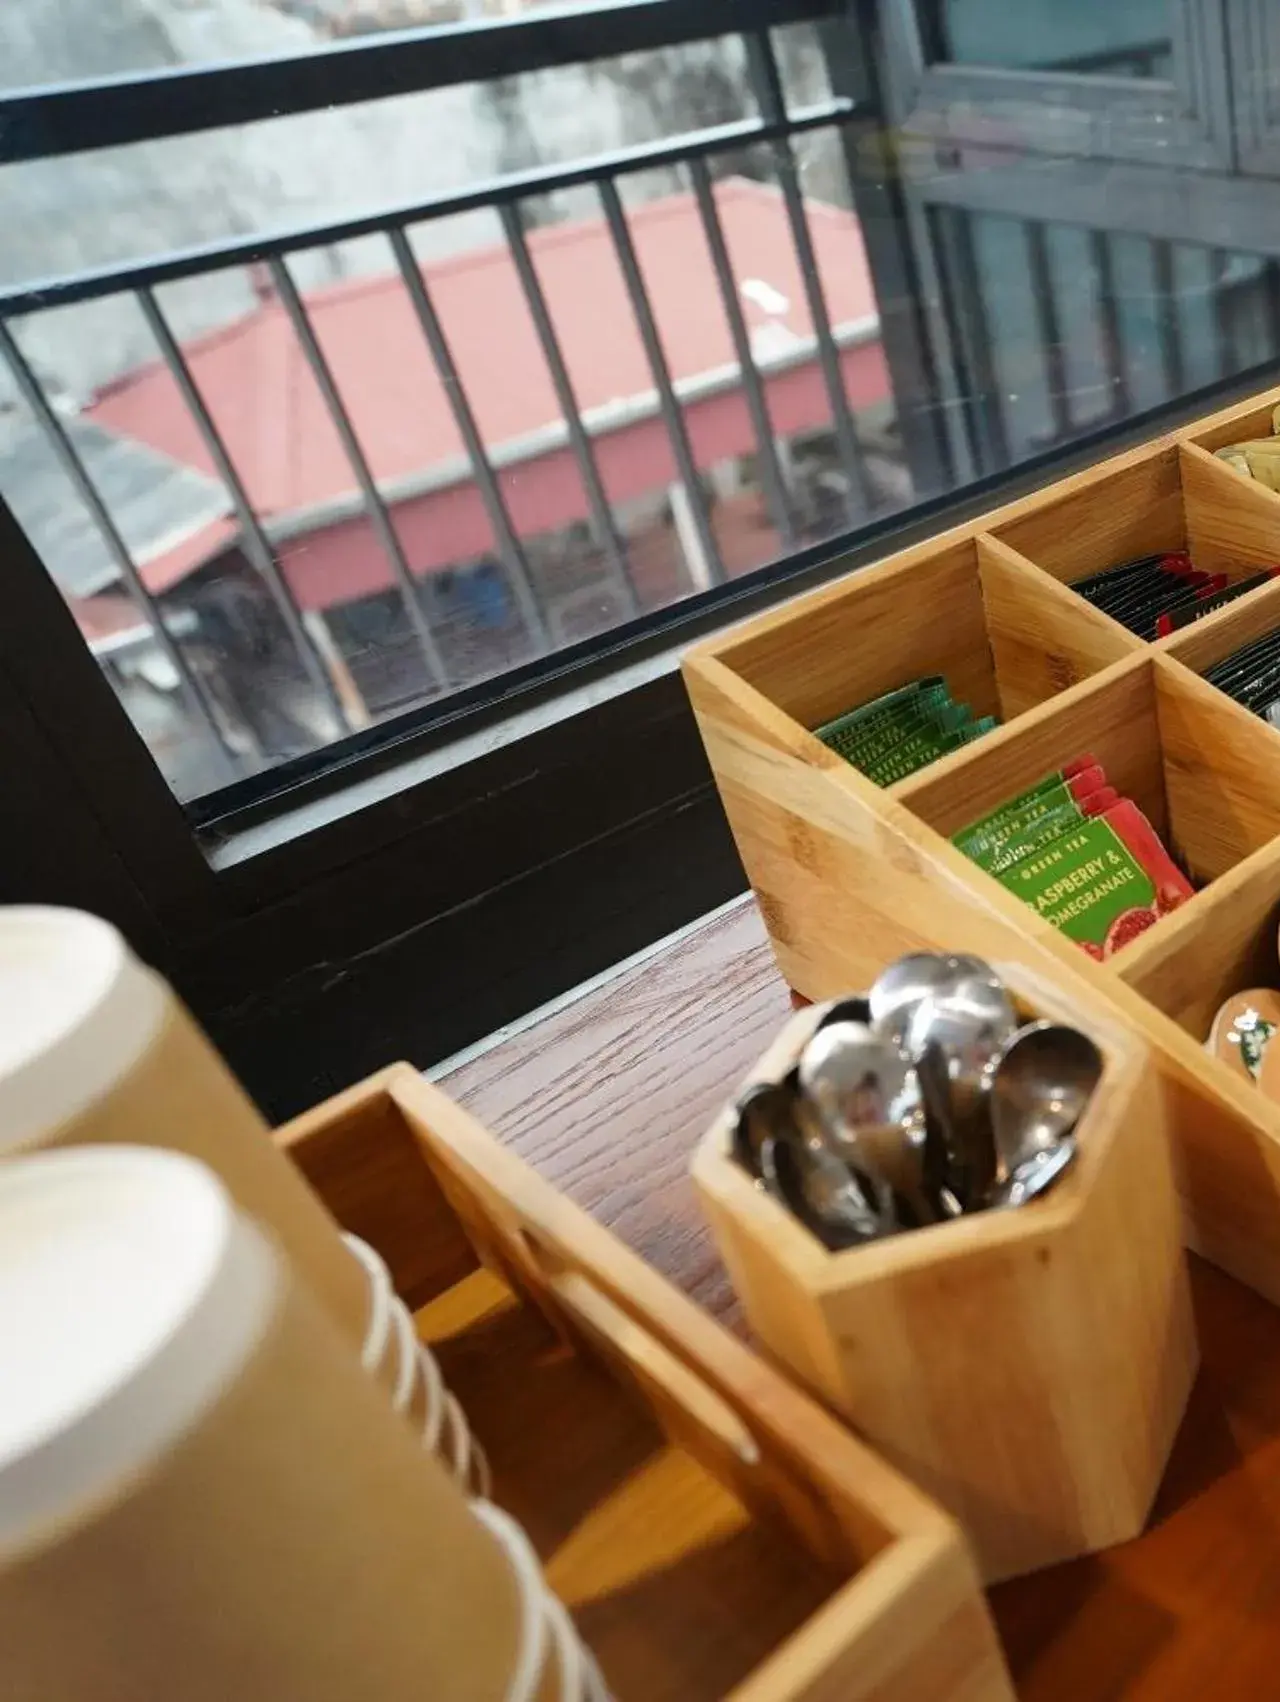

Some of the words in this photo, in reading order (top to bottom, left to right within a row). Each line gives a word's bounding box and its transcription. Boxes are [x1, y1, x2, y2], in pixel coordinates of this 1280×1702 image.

[1020, 850, 1063, 880] GREEN
[1065, 833, 1089, 852] TEA
[1107, 847, 1120, 865] &
[1046, 866, 1134, 928] OMEGRANATE
